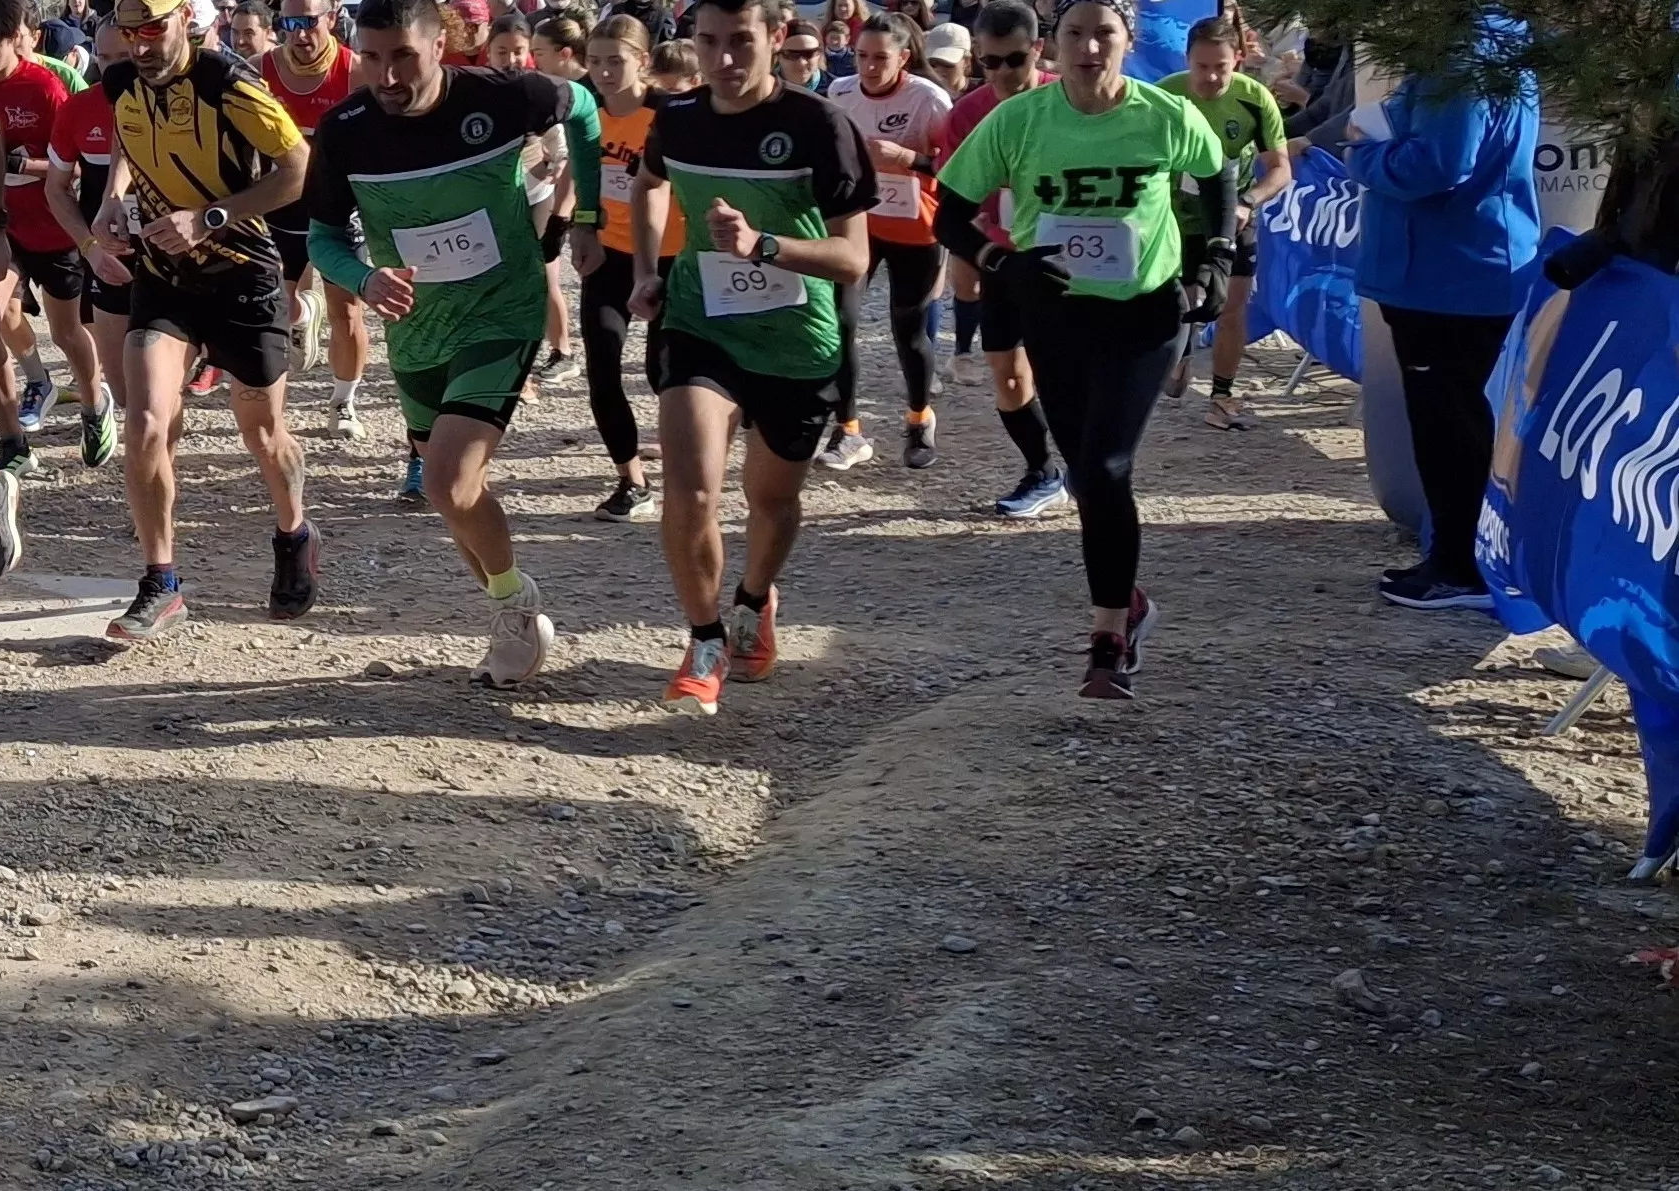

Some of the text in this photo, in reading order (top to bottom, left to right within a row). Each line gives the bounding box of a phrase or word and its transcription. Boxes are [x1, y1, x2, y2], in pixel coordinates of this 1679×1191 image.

[430, 234, 470, 256] 116
[1067, 235, 1104, 258] 63
[731, 270, 767, 292] 69
